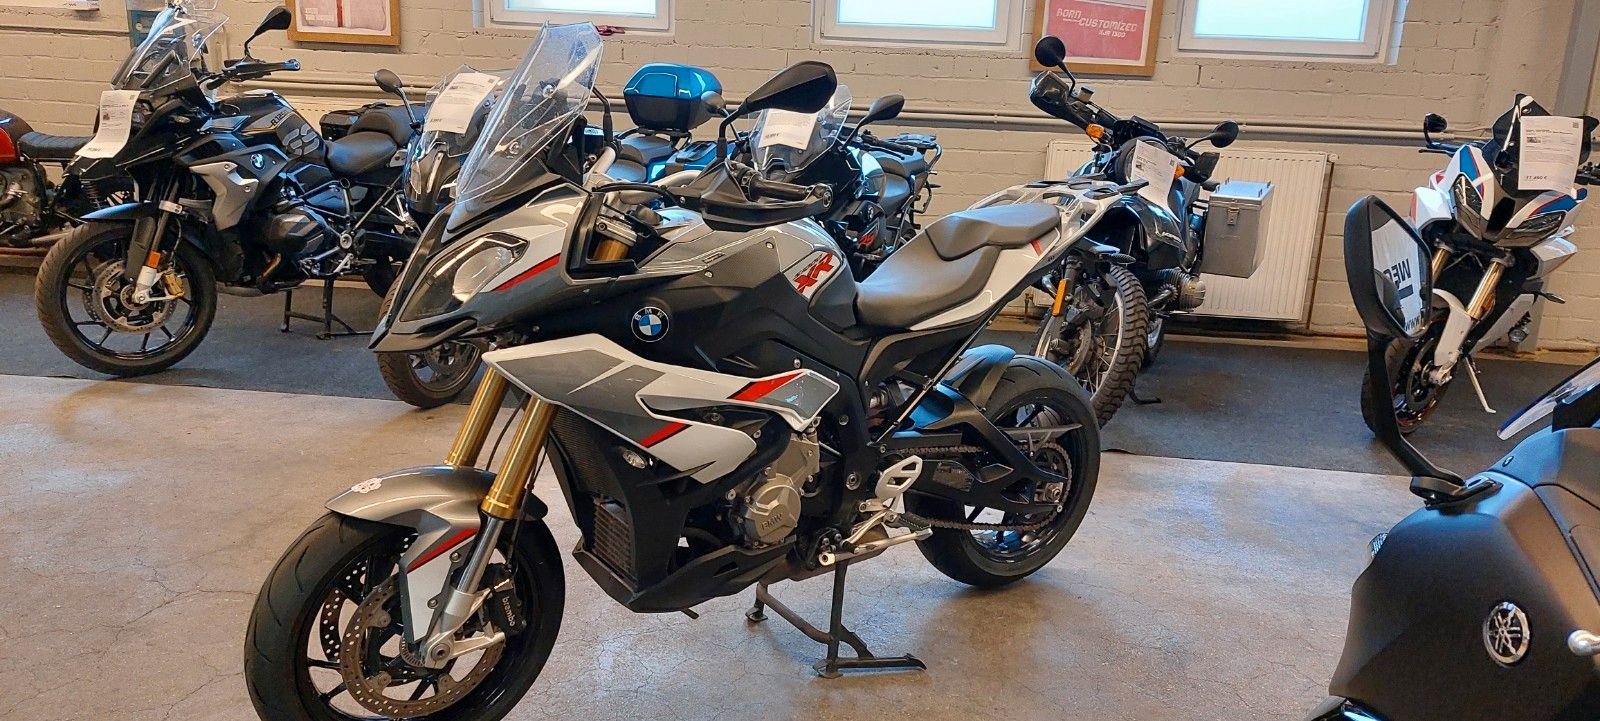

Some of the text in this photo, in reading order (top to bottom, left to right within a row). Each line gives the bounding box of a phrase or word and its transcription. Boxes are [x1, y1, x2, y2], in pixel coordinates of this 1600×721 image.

[1056, 8, 1082, 19] BORN
[1079, 17, 1137, 32] CUSTOMIZED
[502, 596, 516, 627] brembo
